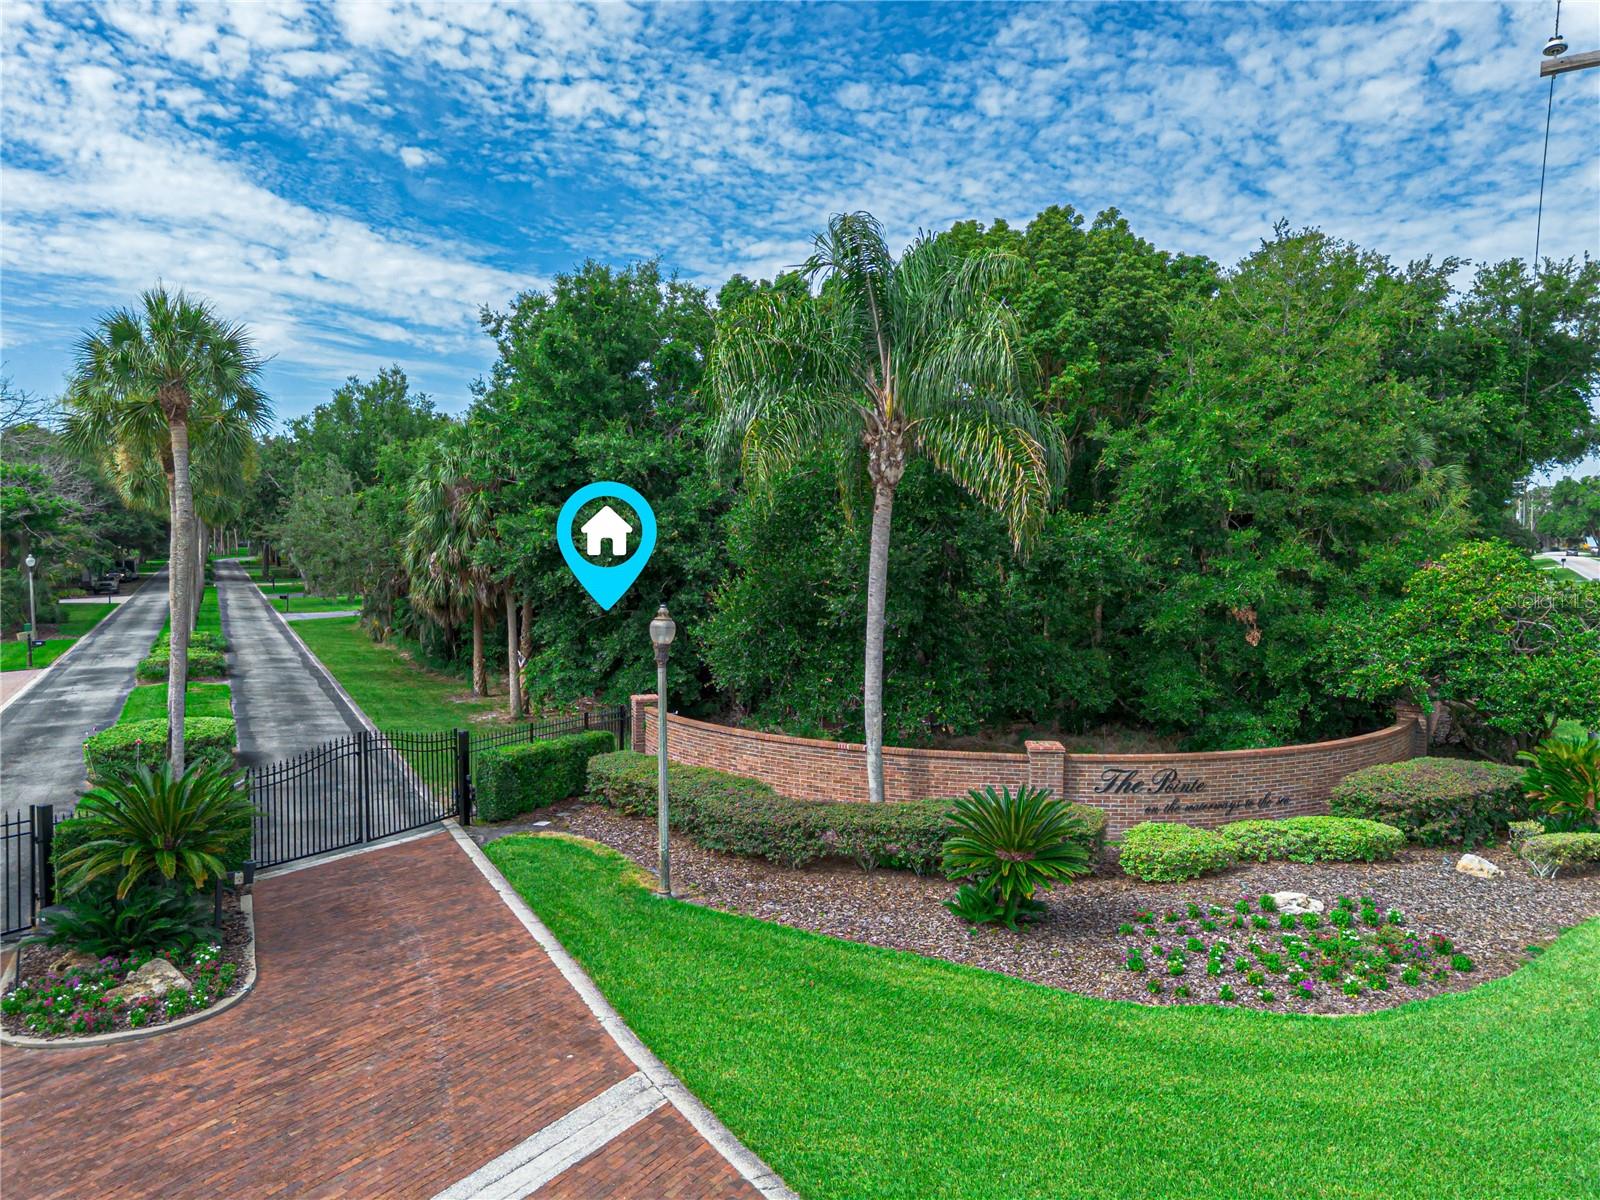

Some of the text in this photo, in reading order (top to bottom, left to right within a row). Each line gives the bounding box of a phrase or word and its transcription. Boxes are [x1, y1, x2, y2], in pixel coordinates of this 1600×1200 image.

[1094, 768, 1206, 794] The Pointe
[1163, 797, 1181, 814] the
